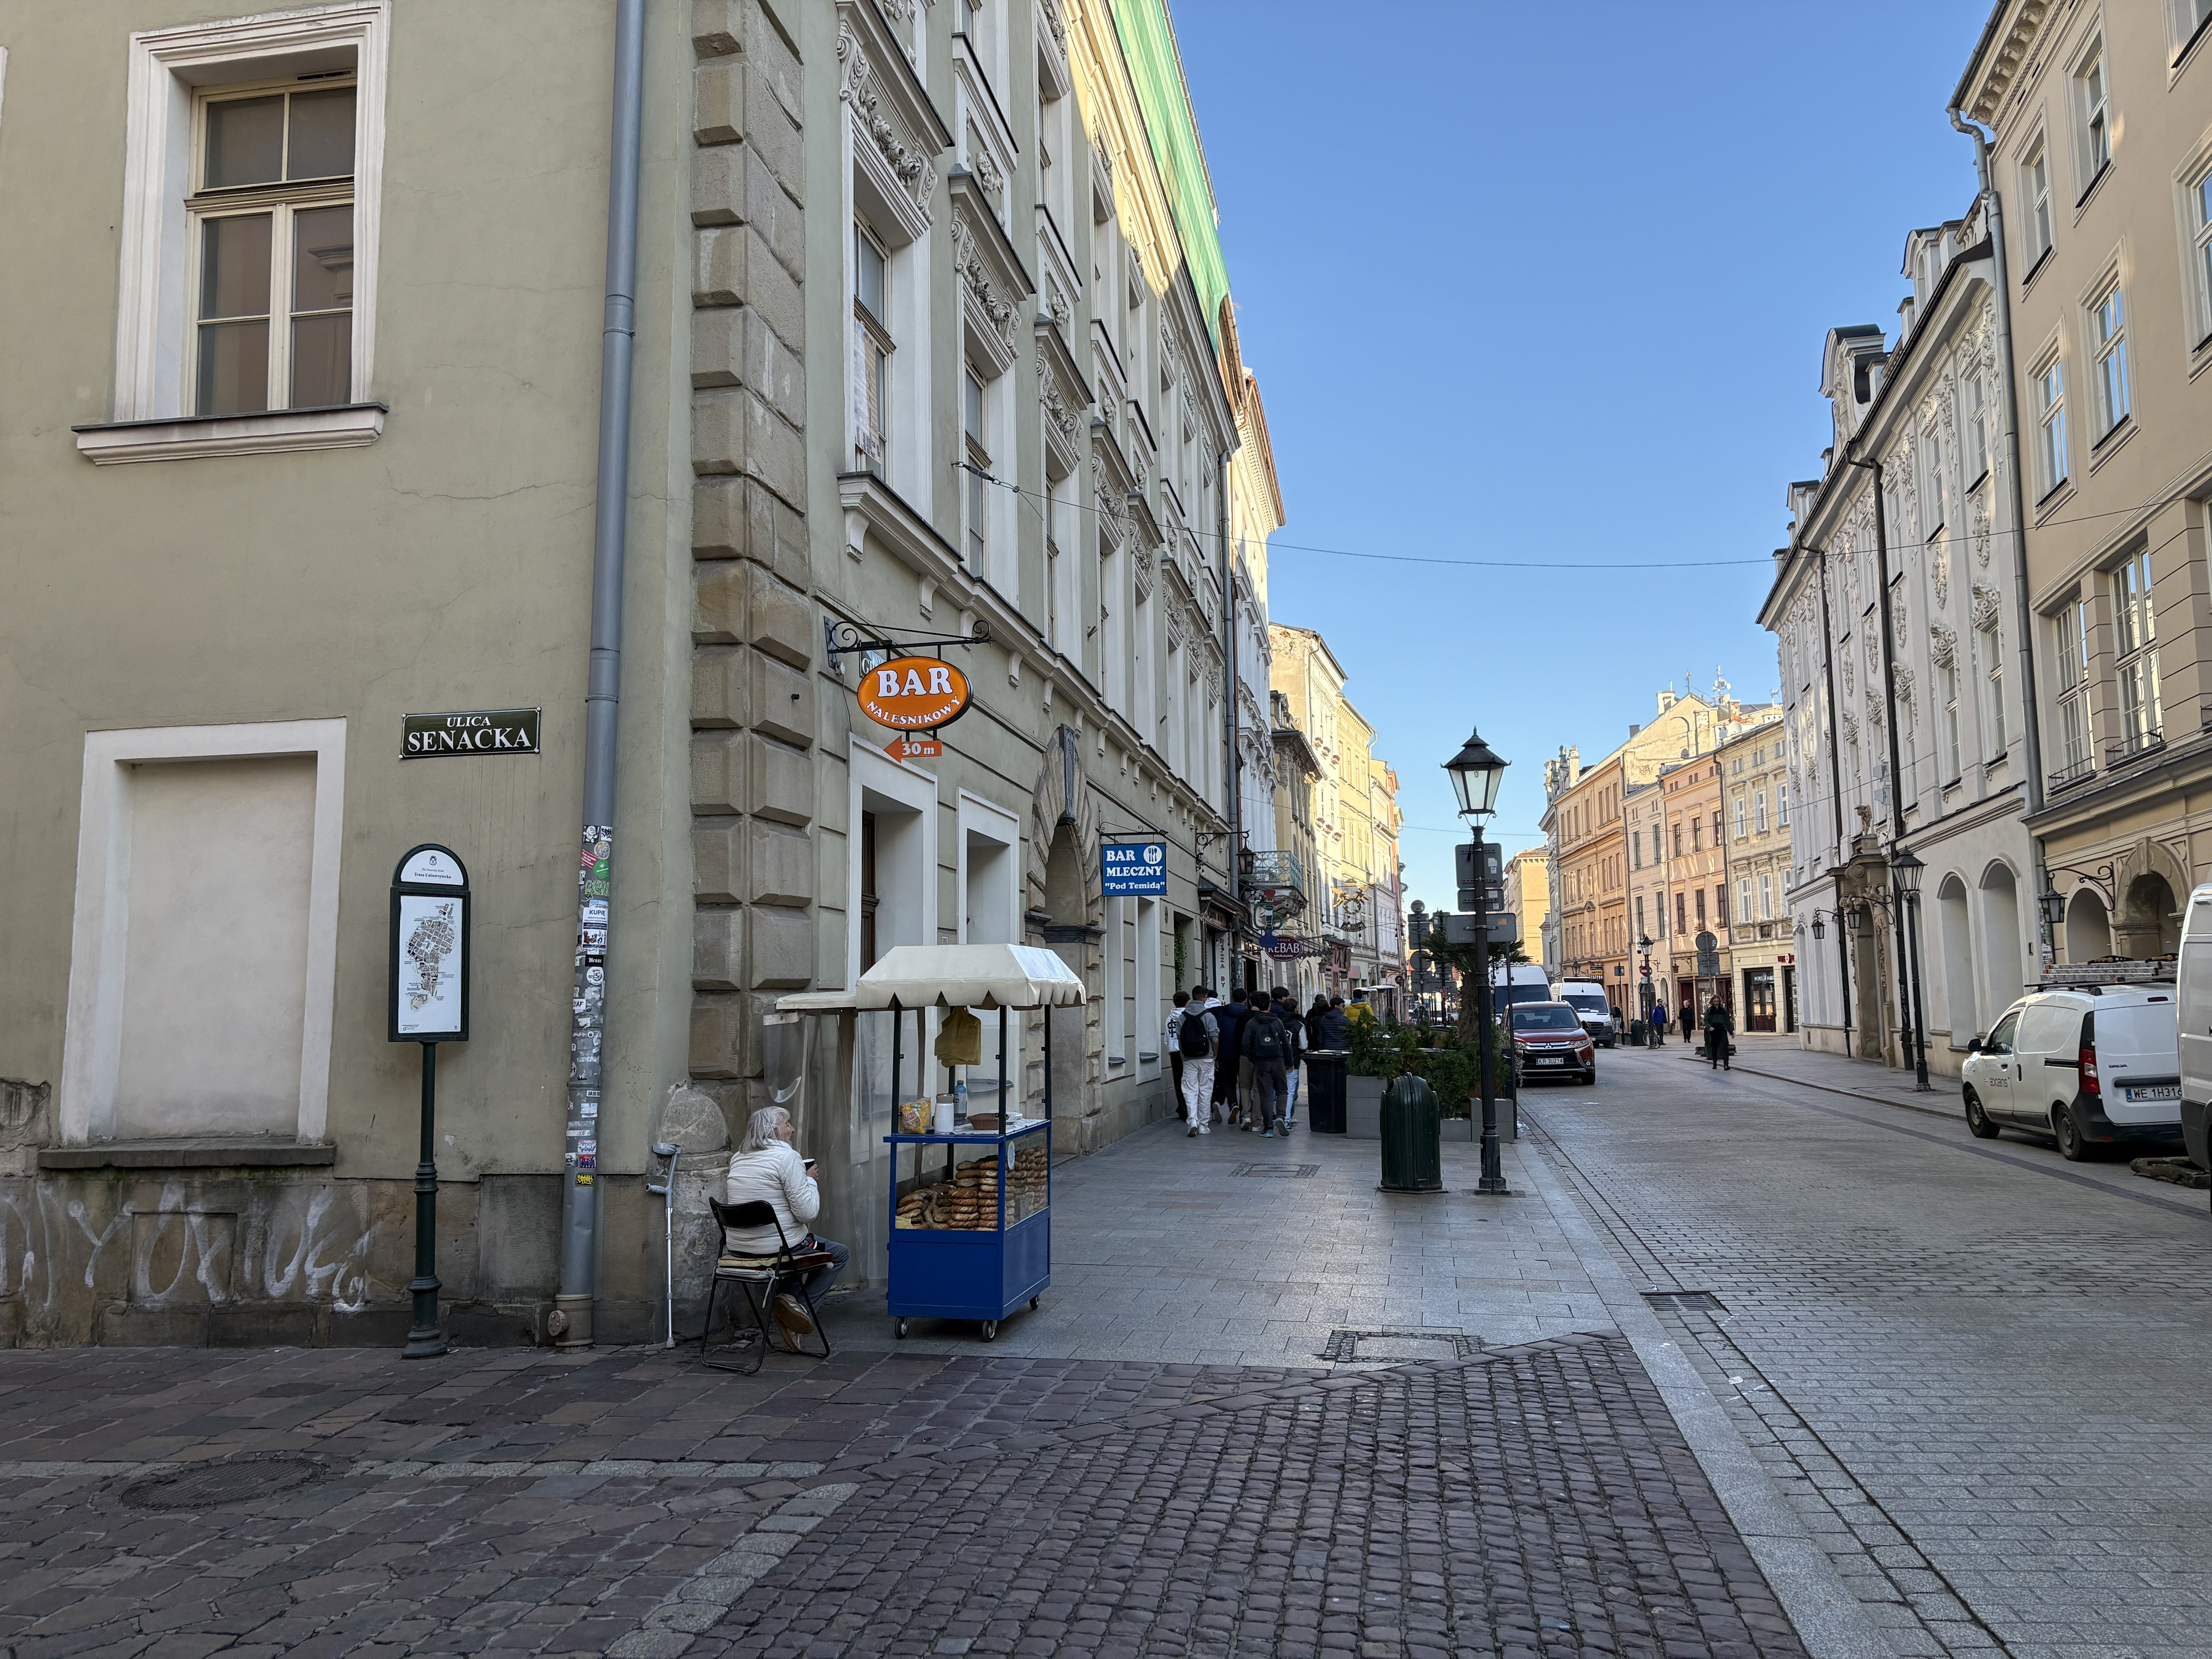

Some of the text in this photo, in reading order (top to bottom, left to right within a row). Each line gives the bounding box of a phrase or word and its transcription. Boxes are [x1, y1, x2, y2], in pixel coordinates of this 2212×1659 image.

[877, 667, 953, 697] BAR
[866, 695, 961, 724] NALEŚNIKOWY
[446, 716, 491, 727] ULICA
[408, 727, 532, 752] SENACKA
[901, 743, 935, 756] 30 m
[1106, 850, 1136, 862] BAR
[1106, 866, 1163, 877] MLECZNY
[1128, 881, 1165, 890] Temidą"
[2133, 1087, 2182, 1098] WE 1H316
